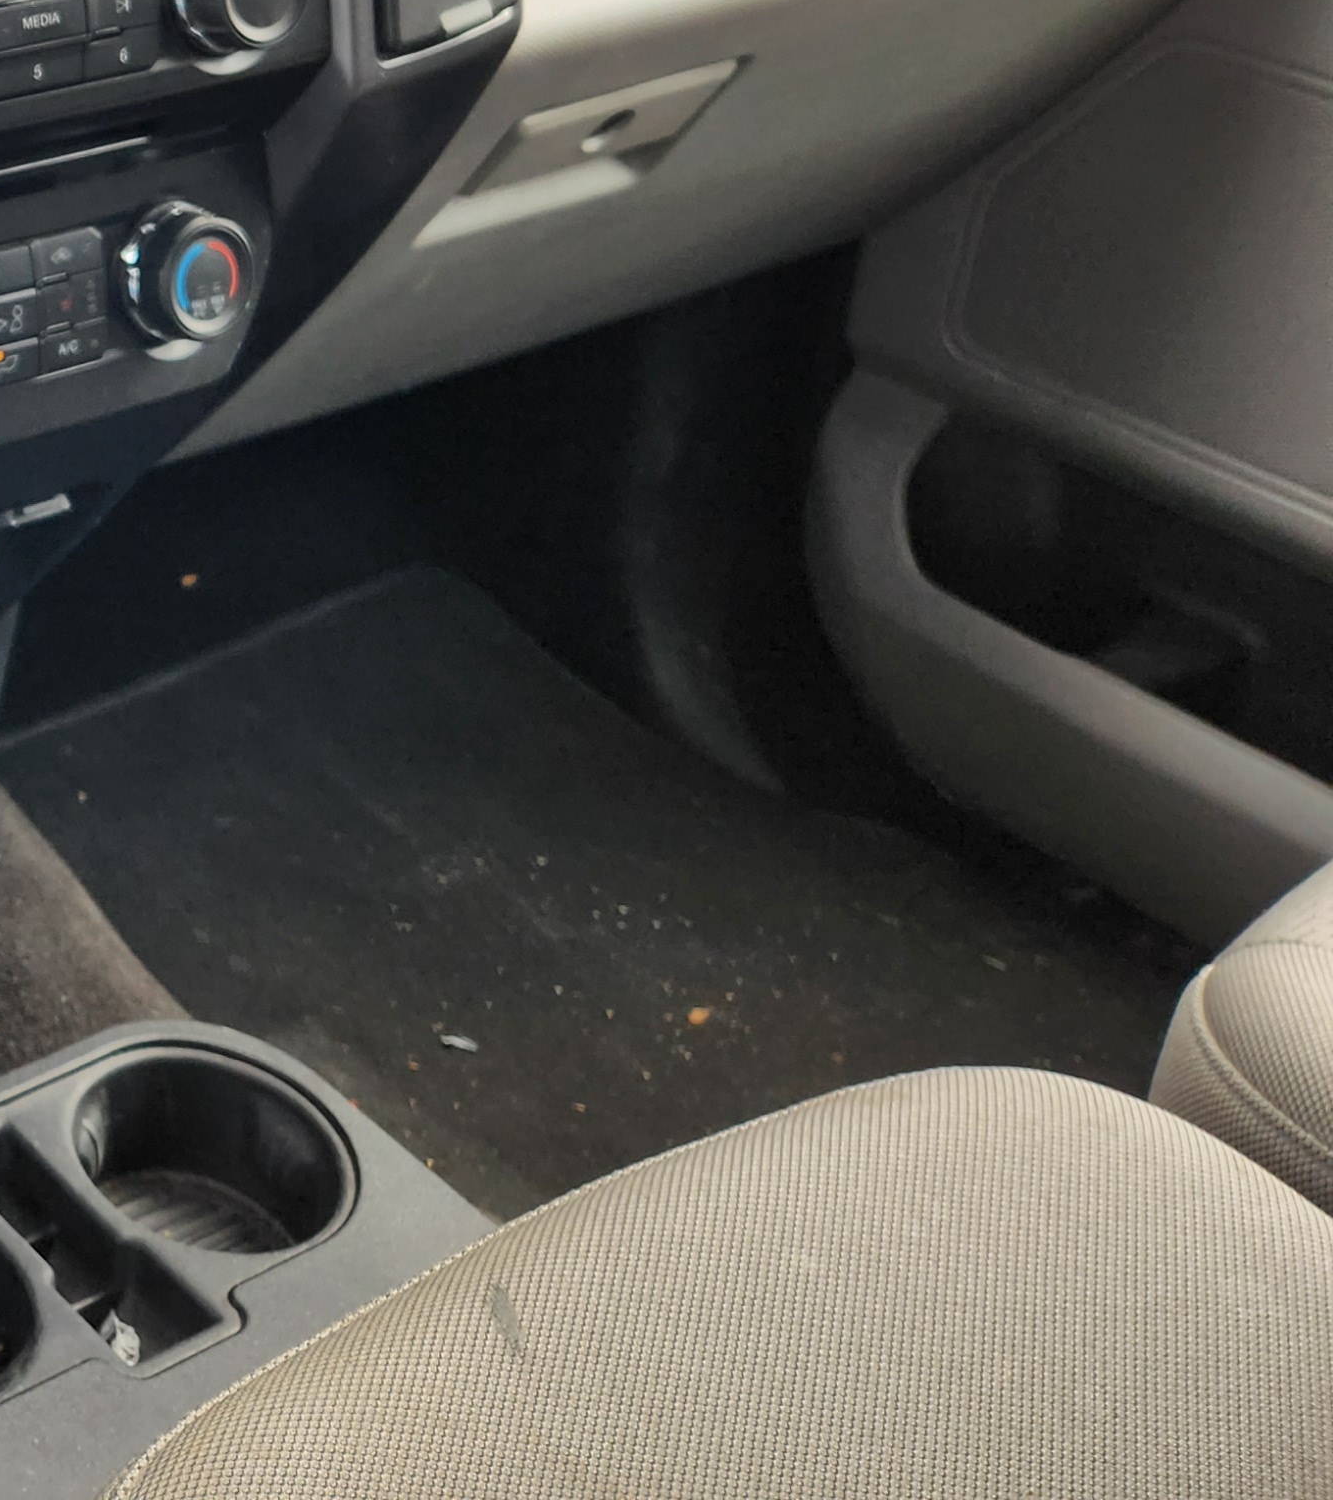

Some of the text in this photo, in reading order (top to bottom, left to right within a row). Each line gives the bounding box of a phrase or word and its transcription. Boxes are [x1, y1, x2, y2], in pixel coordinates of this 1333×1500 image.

[22, 11, 61, 31] MEDIA
[119, 47, 129, 65] 6
[33, 63, 43, 81] 5
